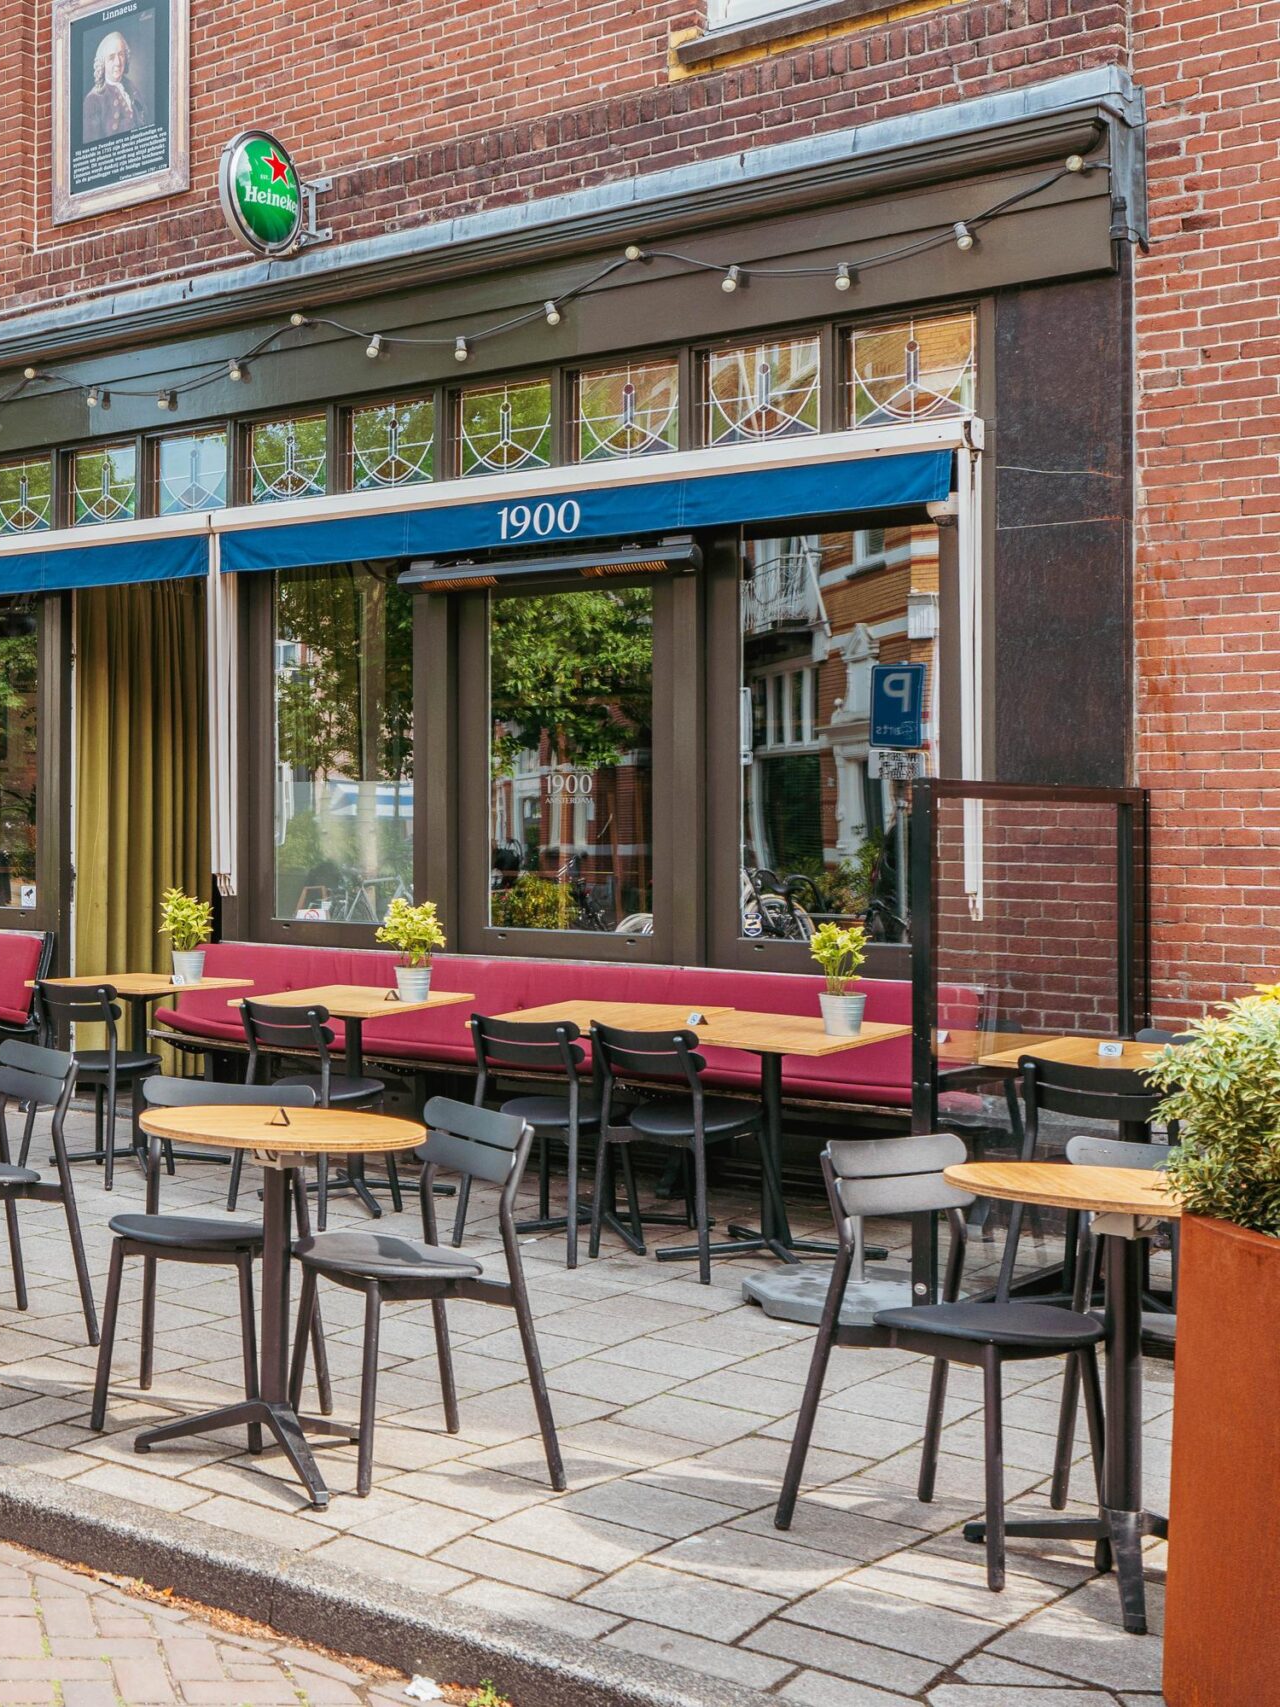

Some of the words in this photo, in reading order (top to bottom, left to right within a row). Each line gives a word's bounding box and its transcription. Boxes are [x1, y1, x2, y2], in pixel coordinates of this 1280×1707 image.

[102, 2, 138, 21] Linnaeus
[244, 185, 298, 215] Heineke
[497, 499, 581, 540] 1900
[545, 774, 593, 794] 1900
